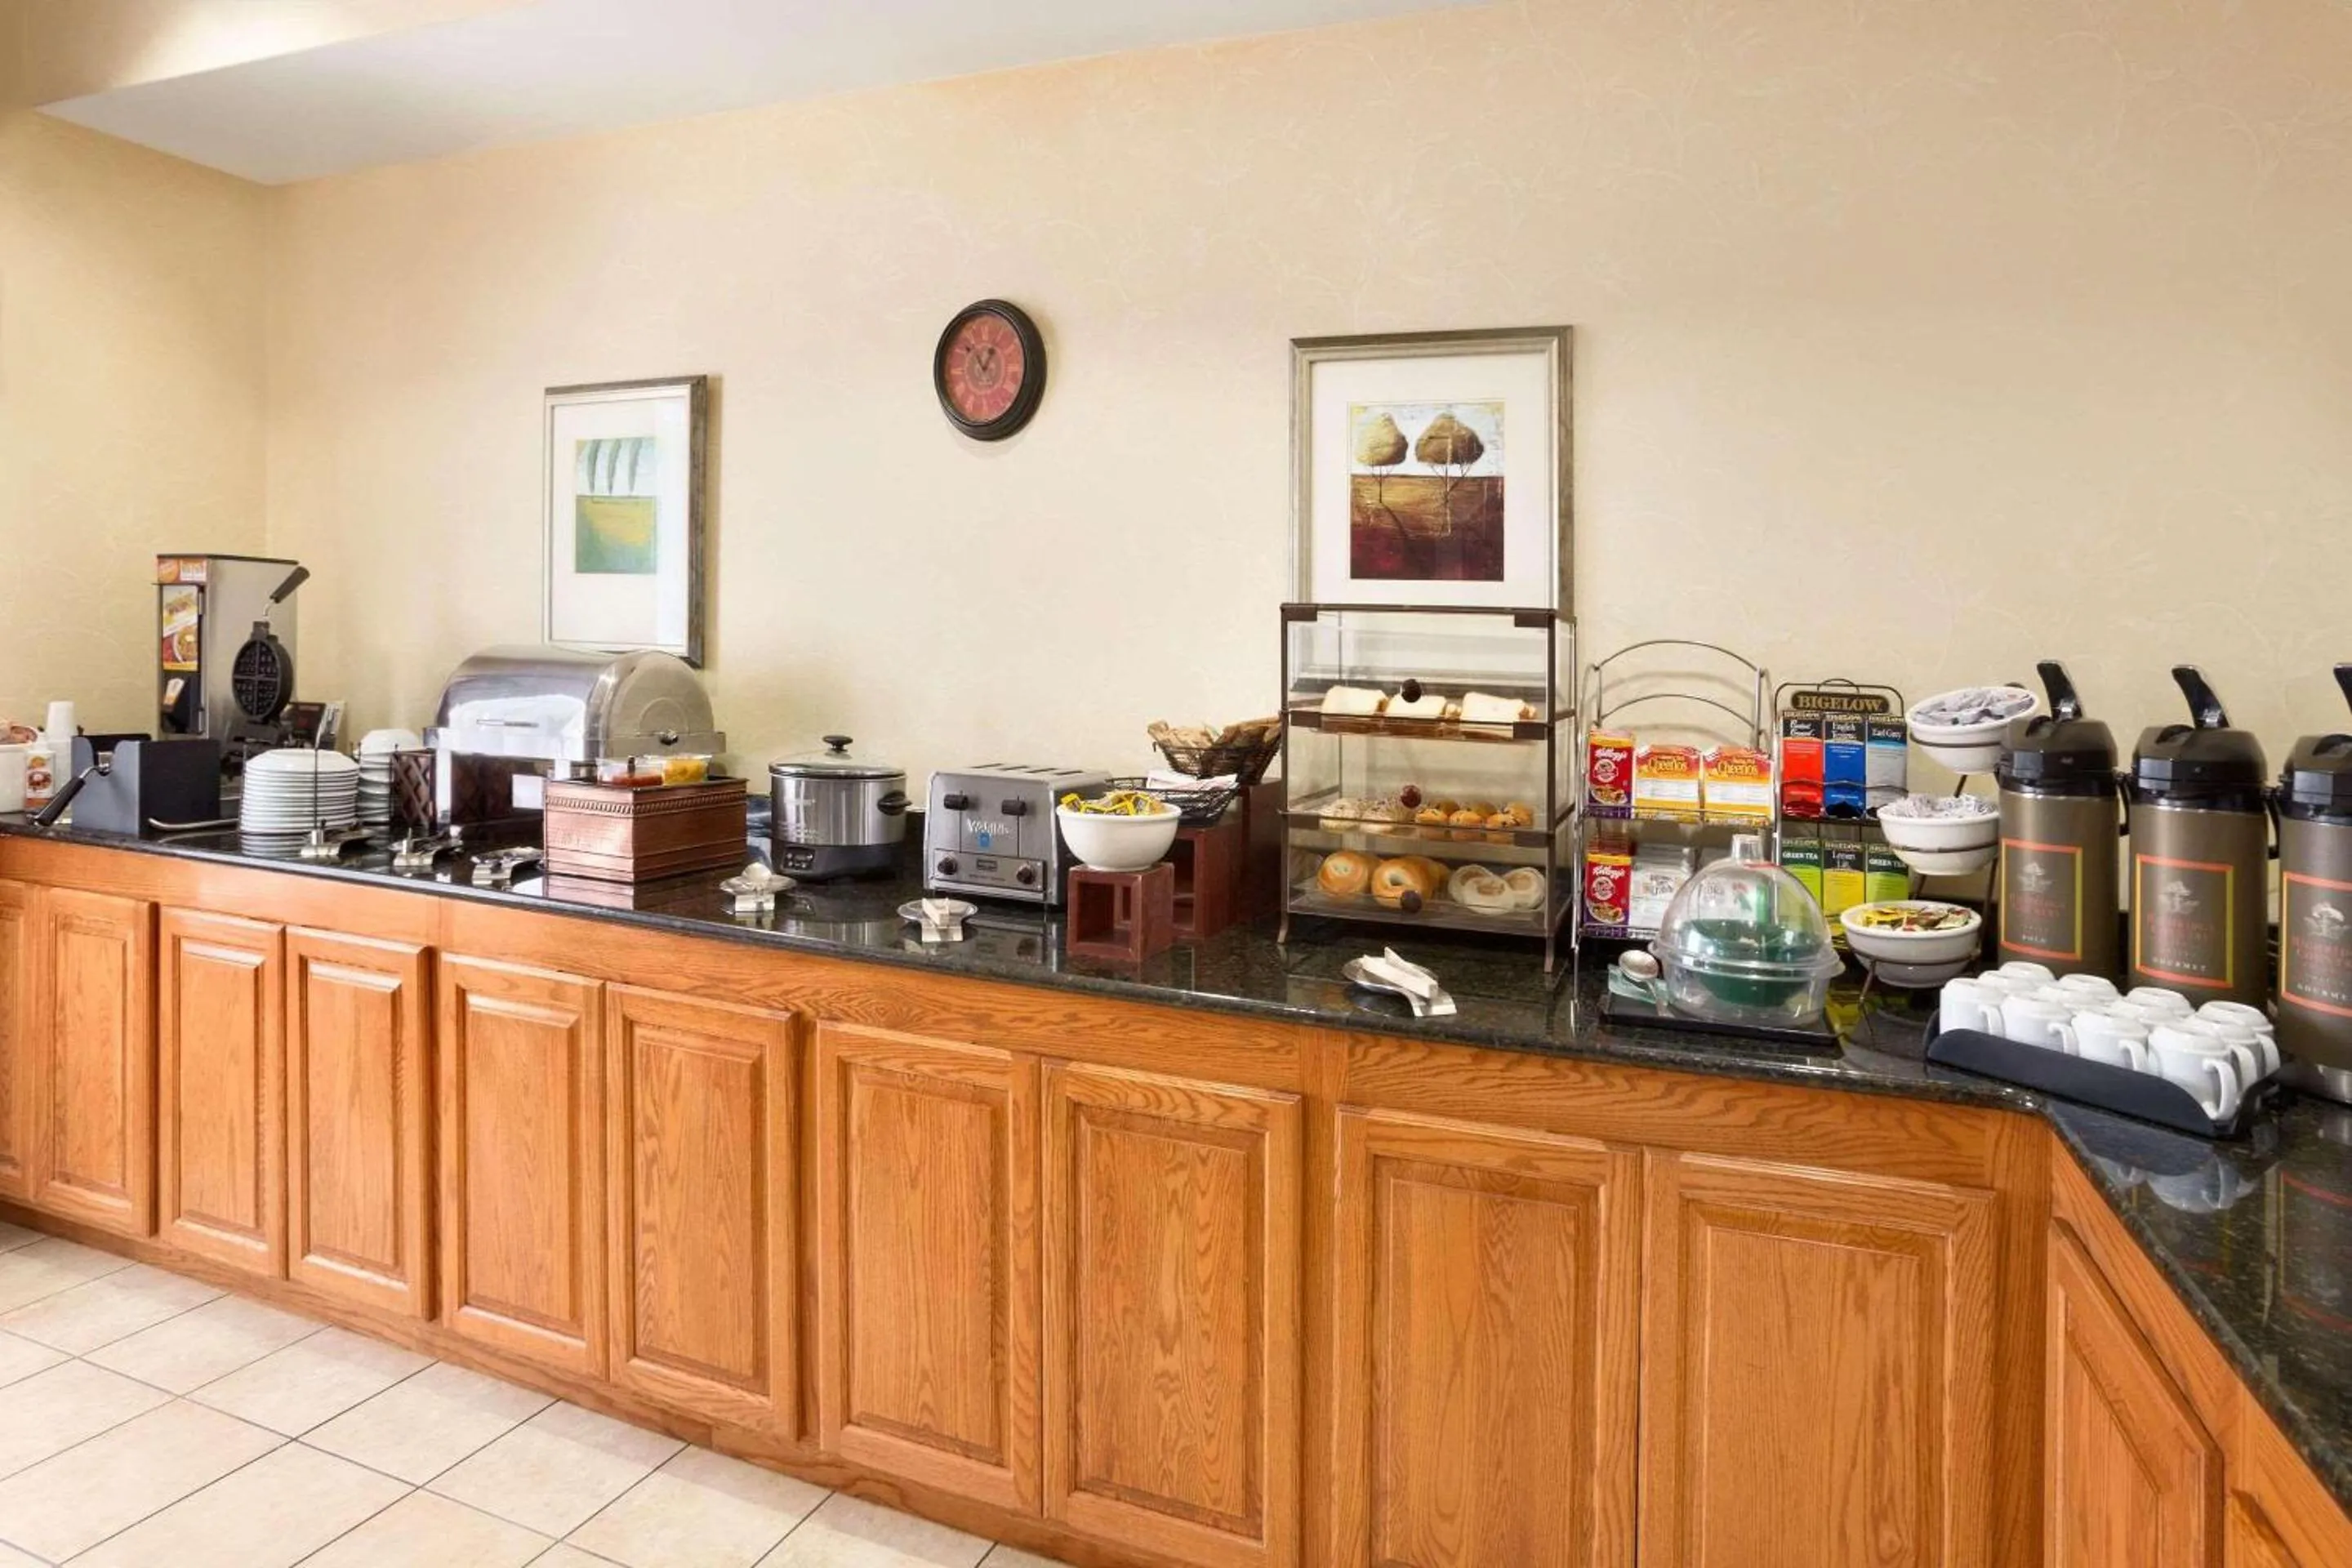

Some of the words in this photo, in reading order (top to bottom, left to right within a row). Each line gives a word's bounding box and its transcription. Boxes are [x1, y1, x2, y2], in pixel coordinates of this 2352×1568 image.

[1797, 695, 1882, 713] BIGELOW
[1647, 756, 1687, 773] Cheerios
[1717, 760, 1758, 776] Cheerios
[1782, 851, 1805, 859] GREEN
[1806, 852, 1818, 860] TEA
[1869, 858, 1892, 866] GREEN
[2296, 982, 2352, 1001] GOURME
